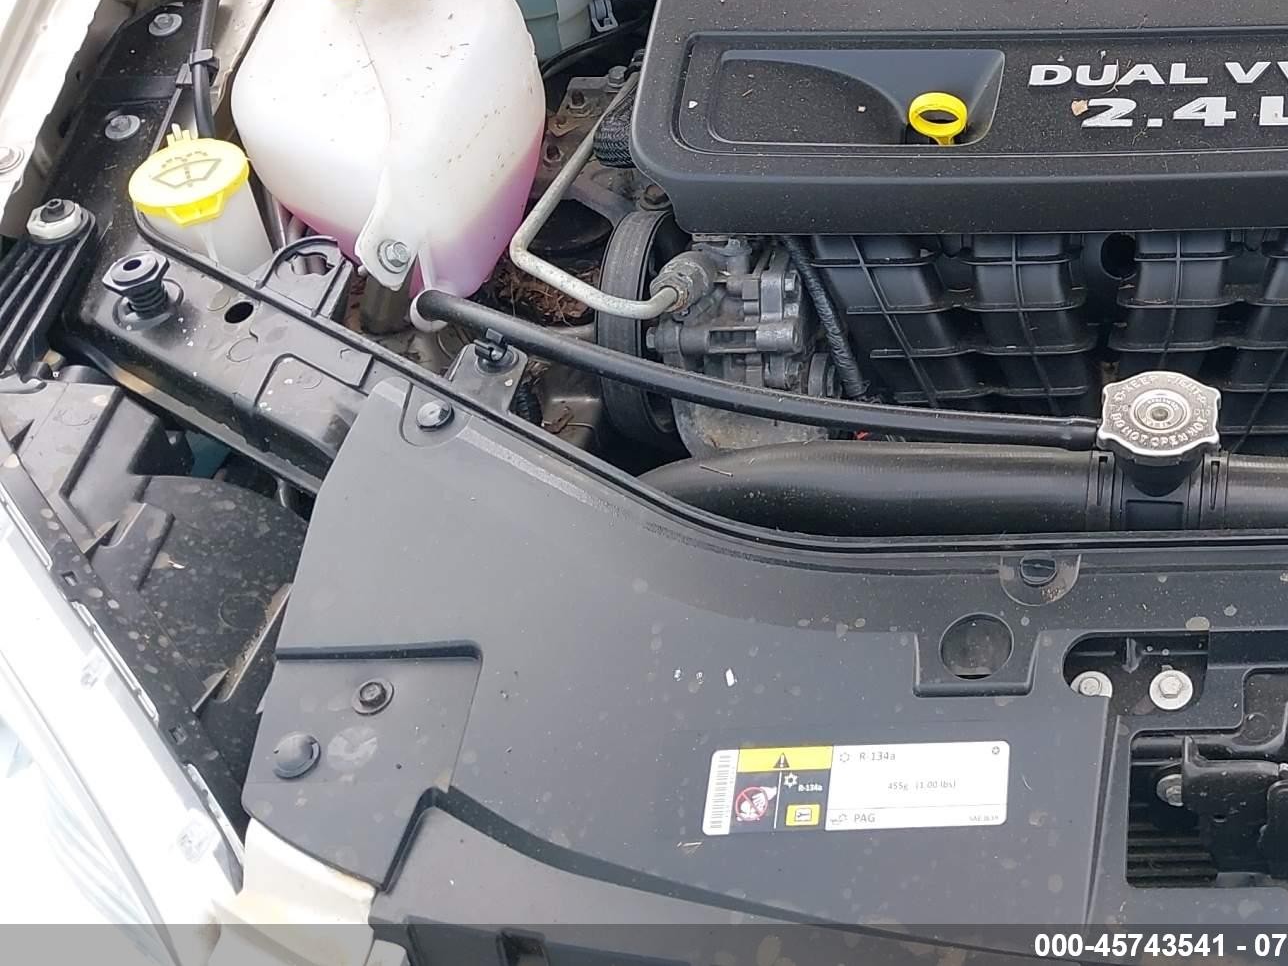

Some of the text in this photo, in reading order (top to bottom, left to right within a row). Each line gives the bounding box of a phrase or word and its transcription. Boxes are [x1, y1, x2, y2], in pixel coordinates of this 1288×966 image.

[1028, 62, 1209, 86] DUAL
[1150, 434, 1189, 447] OPEN
[854, 813, 876, 823] PAG
